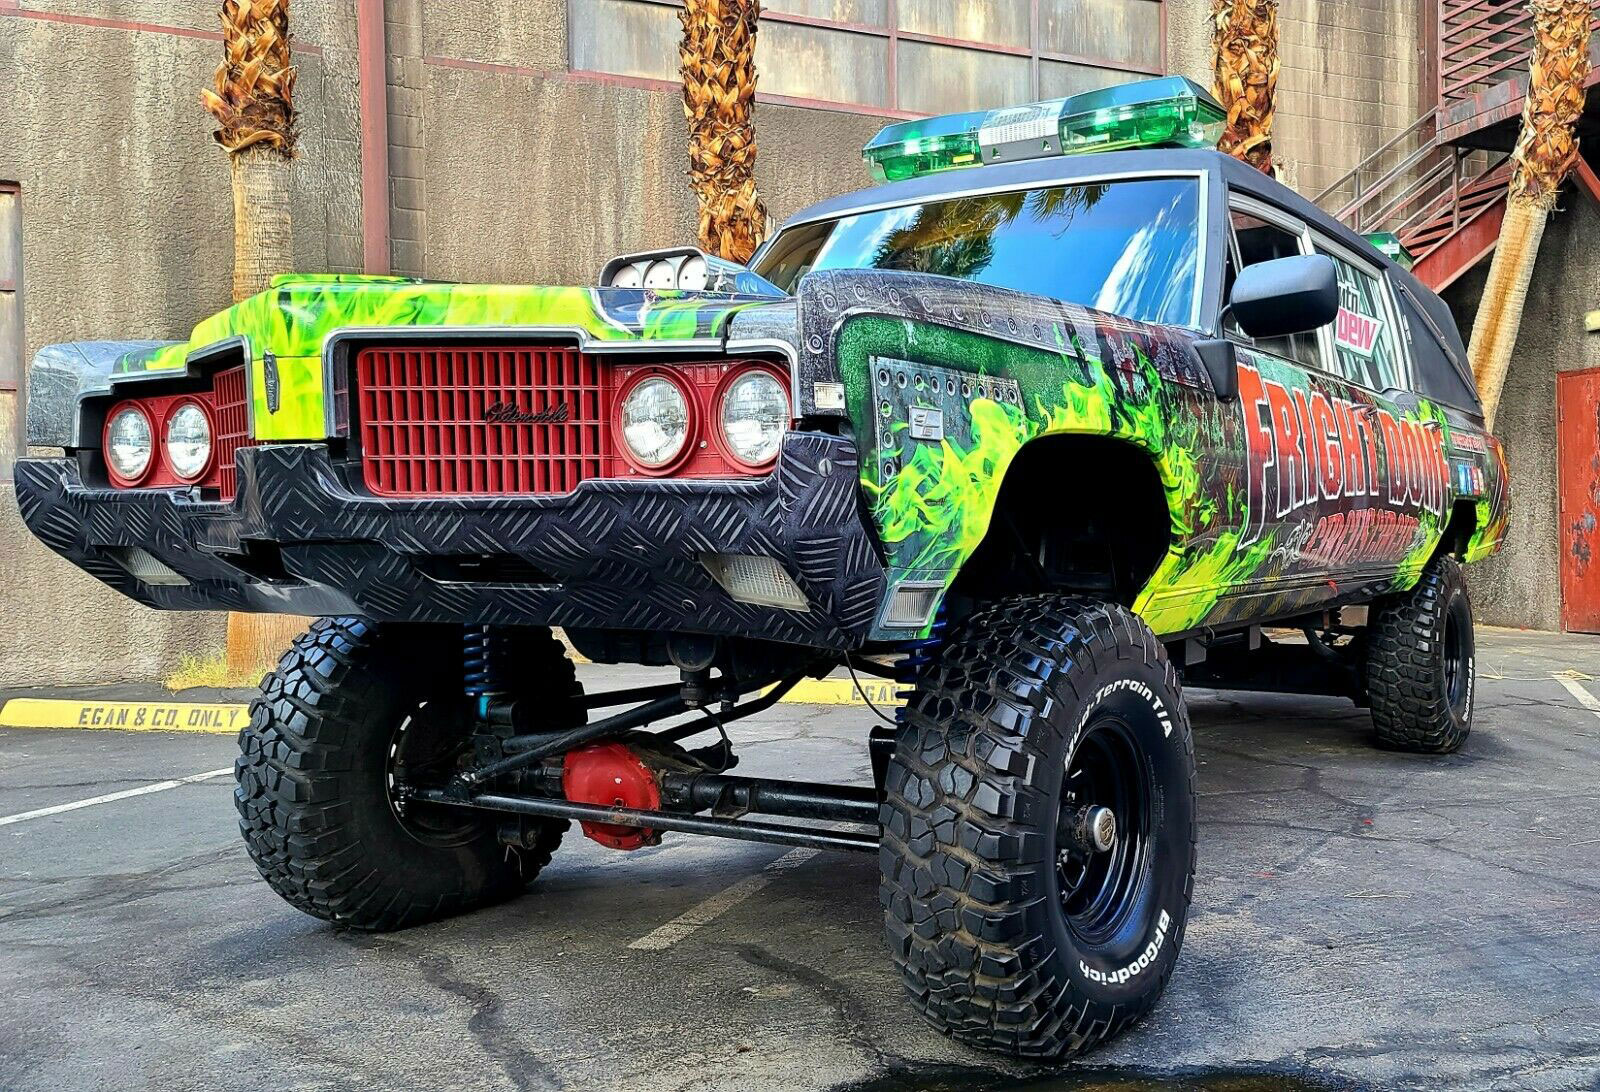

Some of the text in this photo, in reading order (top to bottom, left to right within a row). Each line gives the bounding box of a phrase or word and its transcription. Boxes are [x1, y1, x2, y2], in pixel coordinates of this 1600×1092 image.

[1237, 362, 1379, 551] FRIGHT
[79, 707, 239, 728] EGAN & CO. ONLY
[1079, 908, 1170, 986] BFGoodrich
